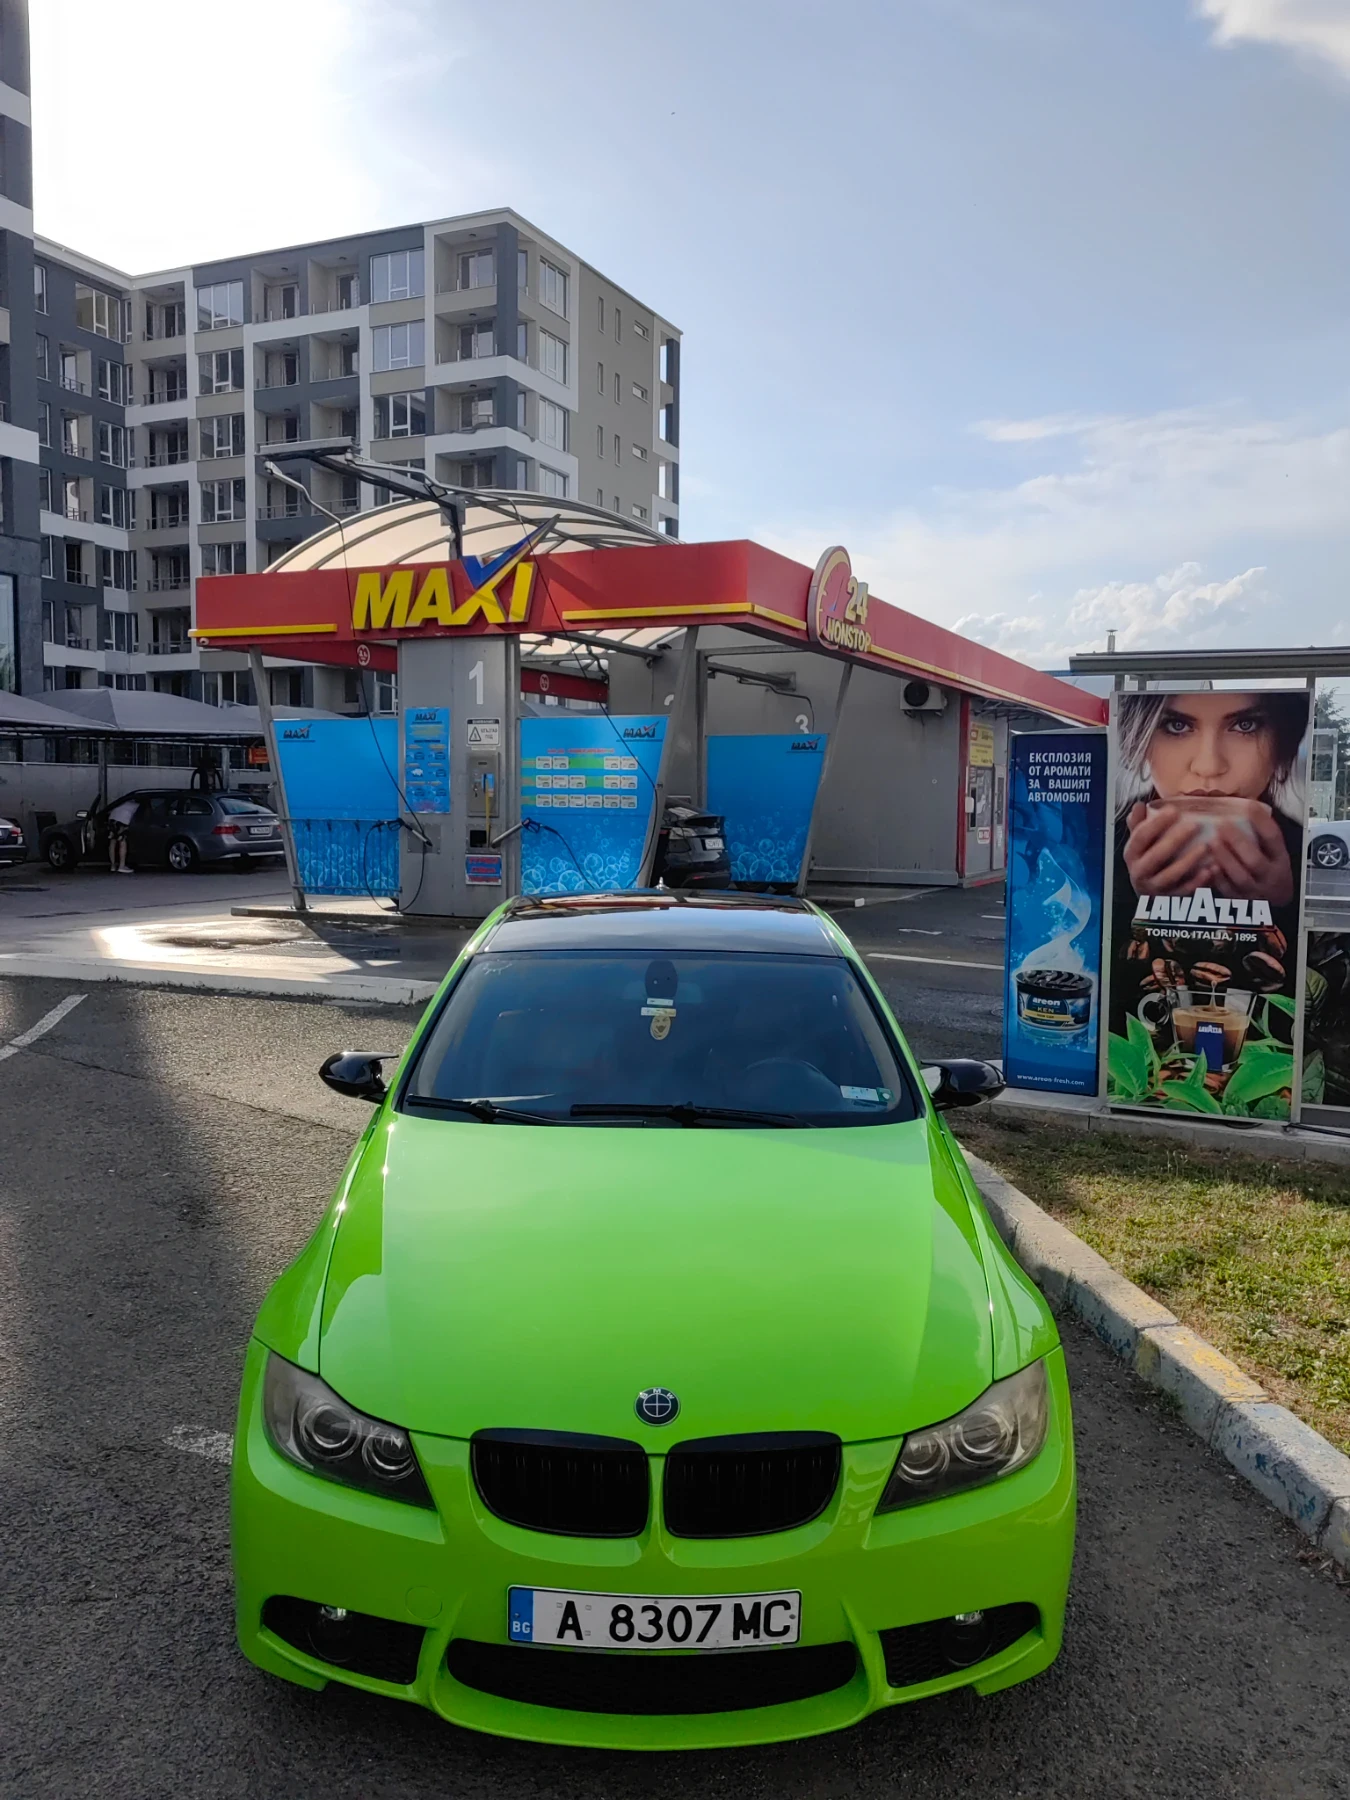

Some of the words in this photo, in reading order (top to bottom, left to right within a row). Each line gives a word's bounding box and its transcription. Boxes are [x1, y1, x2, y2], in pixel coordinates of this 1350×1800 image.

[352, 547, 537, 630] MAXI
[845, 576, 869, 625] 24
[826, 616, 872, 653] NONSTOP
[468, 661, 484, 704] 1
[623, 726, 656, 738] MAXI
[1029, 752, 1092, 763] ЕКСПЛОЗИЯ
[1028, 766, 1041, 776] ОТ
[1043, 766, 1091, 776] АРОМАТИ
[1028, 779, 1040, 789] ЗА
[1048, 779, 1091, 789] ВАШИЯТ
[1028, 792, 1090, 803] АВТОМОБИЛ
[1134, 887, 1273, 926] LAVAZZA
[1234, 932, 1258, 942] 1895
[1032, 997, 1061, 1006] areon
[1037, 1006, 1055, 1014] KEN
[512, 1620, 531, 1634] BG
[556, 1600, 584, 1641] A
[609, 1603, 722, 1643] 8307
[732, 1599, 792, 1641] MC
